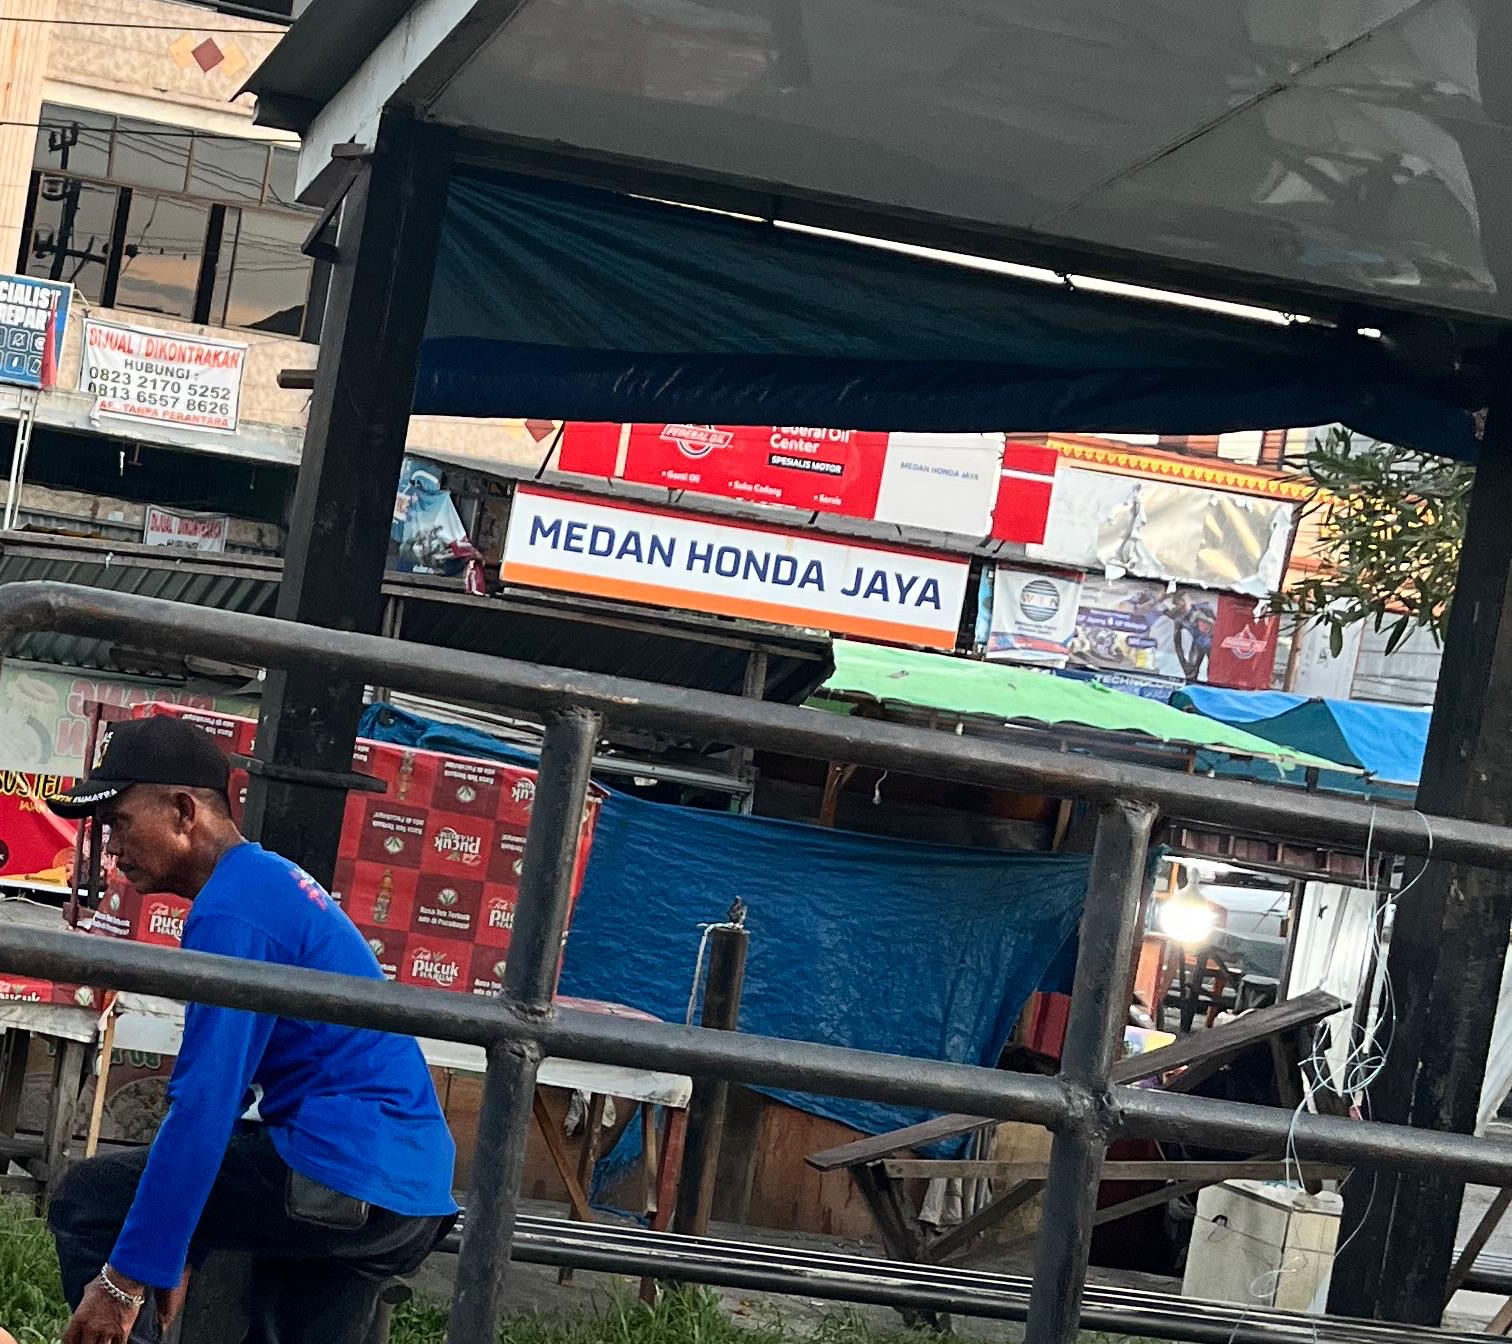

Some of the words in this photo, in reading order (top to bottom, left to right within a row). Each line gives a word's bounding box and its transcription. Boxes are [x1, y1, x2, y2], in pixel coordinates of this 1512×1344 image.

[144, 337, 241, 369] DIKONTRAKAN
[89, 366, 132, 386] 0823
[138, 376, 181, 394] 2170
[188, 384, 231, 401] 5252
[88, 381, 130, 401] 0813
[137, 391, 180, 409] 6557
[187, 399, 229, 416] 8626
[162, 410, 229, 428] PERANTARA
[769, 434, 820, 453] Center
[771, 455, 811, 469] SPESIALIS
[811, 460, 842, 474] MOTOR
[900, 461, 929, 473] MEDAN
[529, 514, 676, 569] MEDAN
[686, 540, 826, 592] HONDA
[840, 566, 942, 611] JAYA
